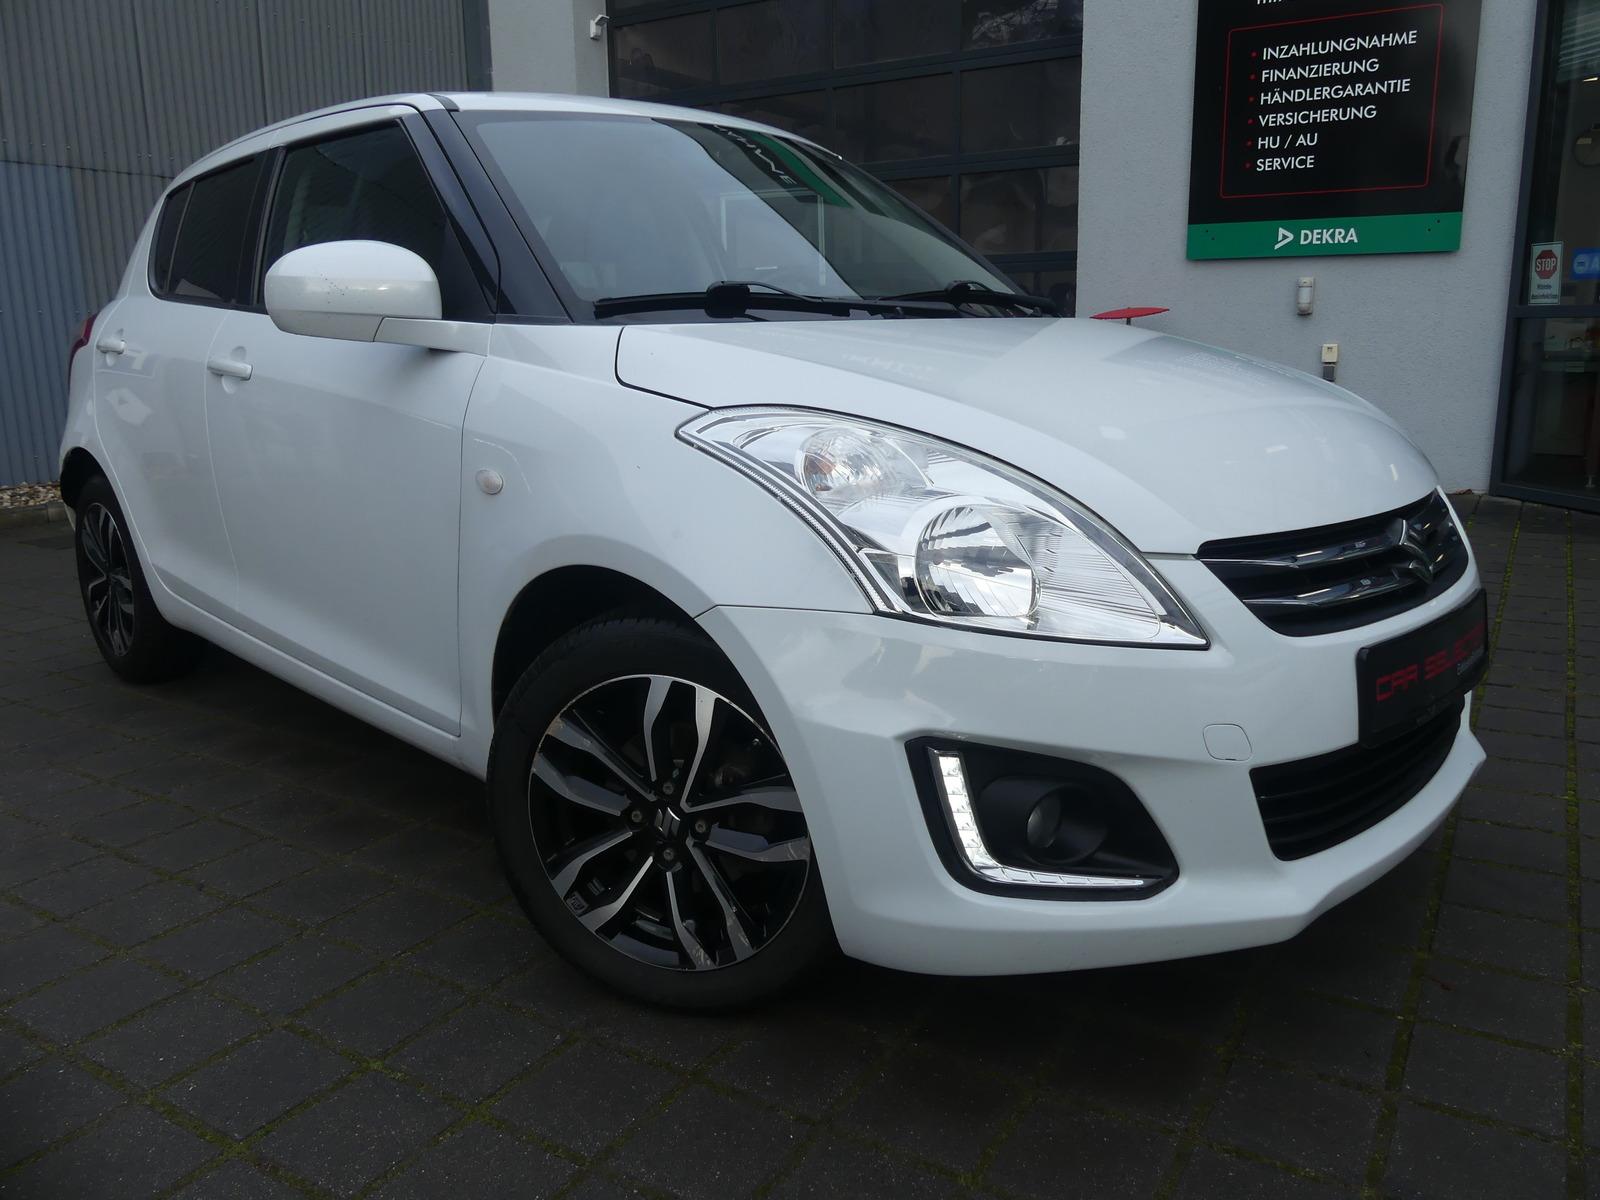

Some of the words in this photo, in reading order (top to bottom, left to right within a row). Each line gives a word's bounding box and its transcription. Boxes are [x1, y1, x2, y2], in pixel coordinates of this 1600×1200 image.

[1262, 30, 1418, 60] INZAHLUNGNAHME
[1261, 58, 1380, 83] FINANZIERUNG
[1260, 78, 1411, 105] HÄNDLERGARANTIE
[1258, 104, 1377, 127] VERSICHERUNG
[1257, 135, 1281, 150] HU
[1283, 133, 1293, 150] /
[1295, 132, 1318, 147] AU
[1256, 154, 1315, 171] SERVICE
[1300, 227, 1358, 245] DEKRA
[1535, 256, 1557, 273] STOP
[1375, 663, 1419, 703] CAR
